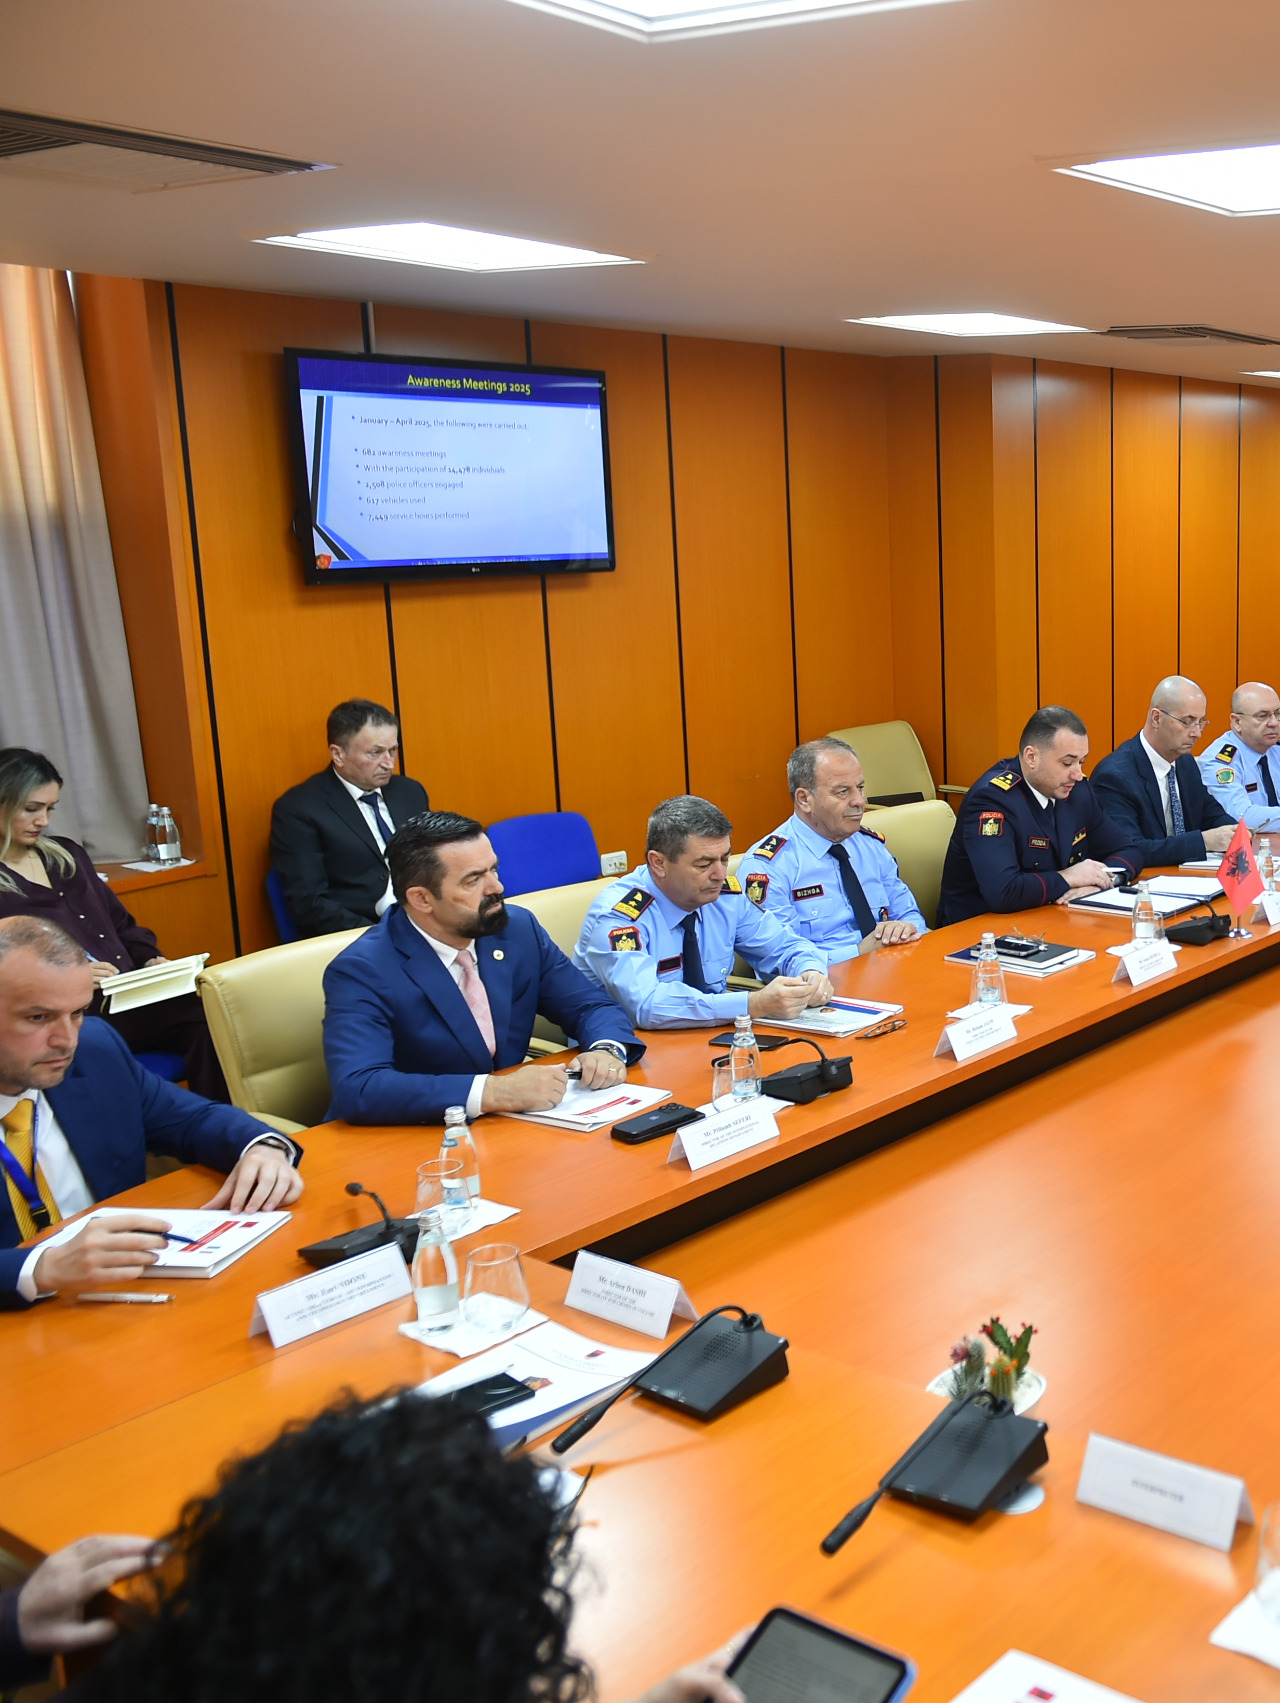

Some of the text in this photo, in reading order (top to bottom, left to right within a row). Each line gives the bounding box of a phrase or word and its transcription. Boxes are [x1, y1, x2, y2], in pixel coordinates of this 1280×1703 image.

[407, 374, 531, 395] Awareness Meetings 2025
[360, 416, 388, 426] January
[396, 417, 412, 427] April
[433, 418, 444, 426] the
[446, 418, 476, 430] following
[494, 421, 515, 430] carried
[362, 448, 375, 456] 682
[415, 450, 446, 460] meetings
[363, 464, 380, 472] With
[382, 464, 393, 472] the
[395, 465, 438, 475] participation
[440, 465, 446, 473] of
[472, 466, 505, 474] individuals
[365, 480, 463, 490] 2,508 police officers engaged
[381, 496, 408, 504] vehicles
[410, 496, 425, 504] used
[415, 512, 433, 520] hours
[434, 512, 469, 521] performed
[612, 928, 634, 936] POLICIA
